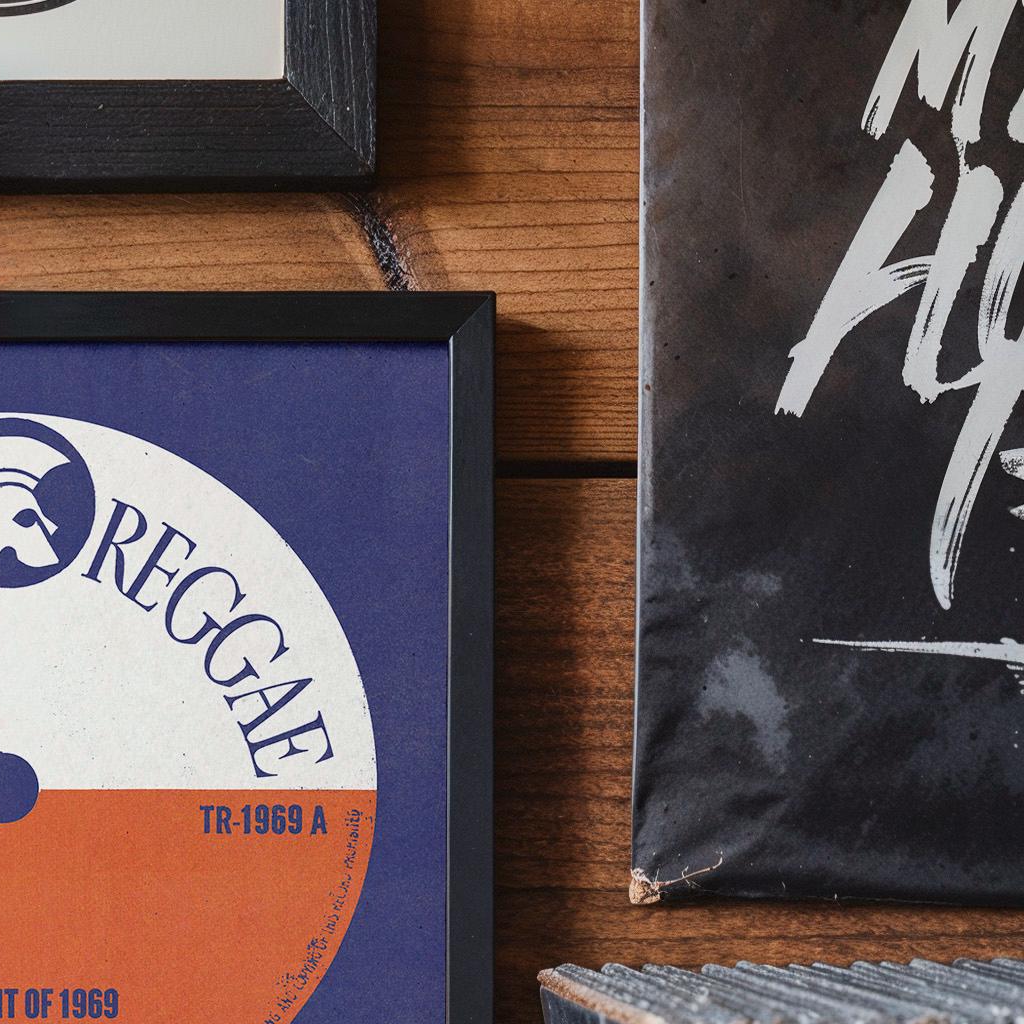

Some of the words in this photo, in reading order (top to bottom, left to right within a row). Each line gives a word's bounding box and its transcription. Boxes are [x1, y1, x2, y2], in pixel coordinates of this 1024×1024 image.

[81, 498, 334, 778] REGGAE
[200, 804, 302, 834] TR-1969
[310, 805, 327, 835] A
[25, 988, 53, 1019] OF
[59, 988, 119, 1019] 1969
